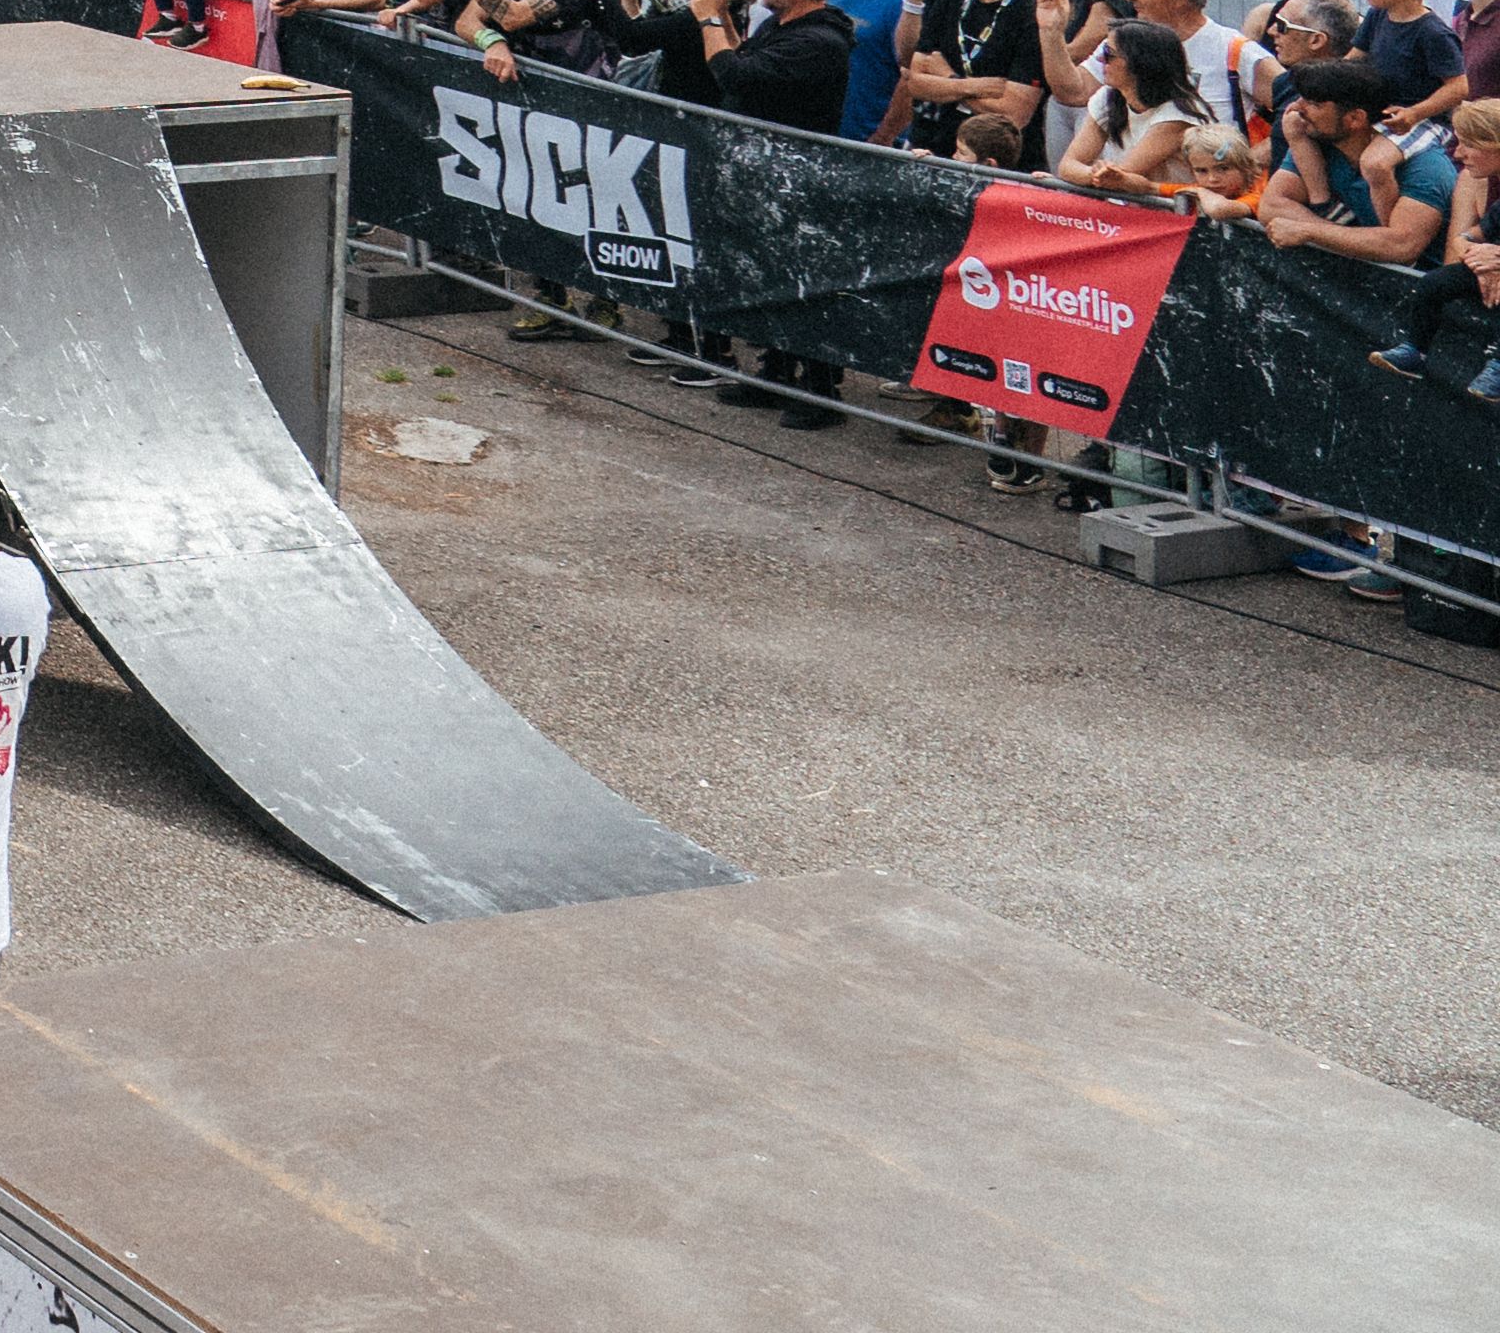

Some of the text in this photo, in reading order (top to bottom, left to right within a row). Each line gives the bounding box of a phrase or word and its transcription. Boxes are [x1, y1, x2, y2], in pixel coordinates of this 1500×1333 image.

[432, 85, 695, 269] SICK!
[1024, 206, 1122, 238] Powered by:
[596, 240, 661, 271] SHOW
[1005, 270, 1135, 336] bikeflip
